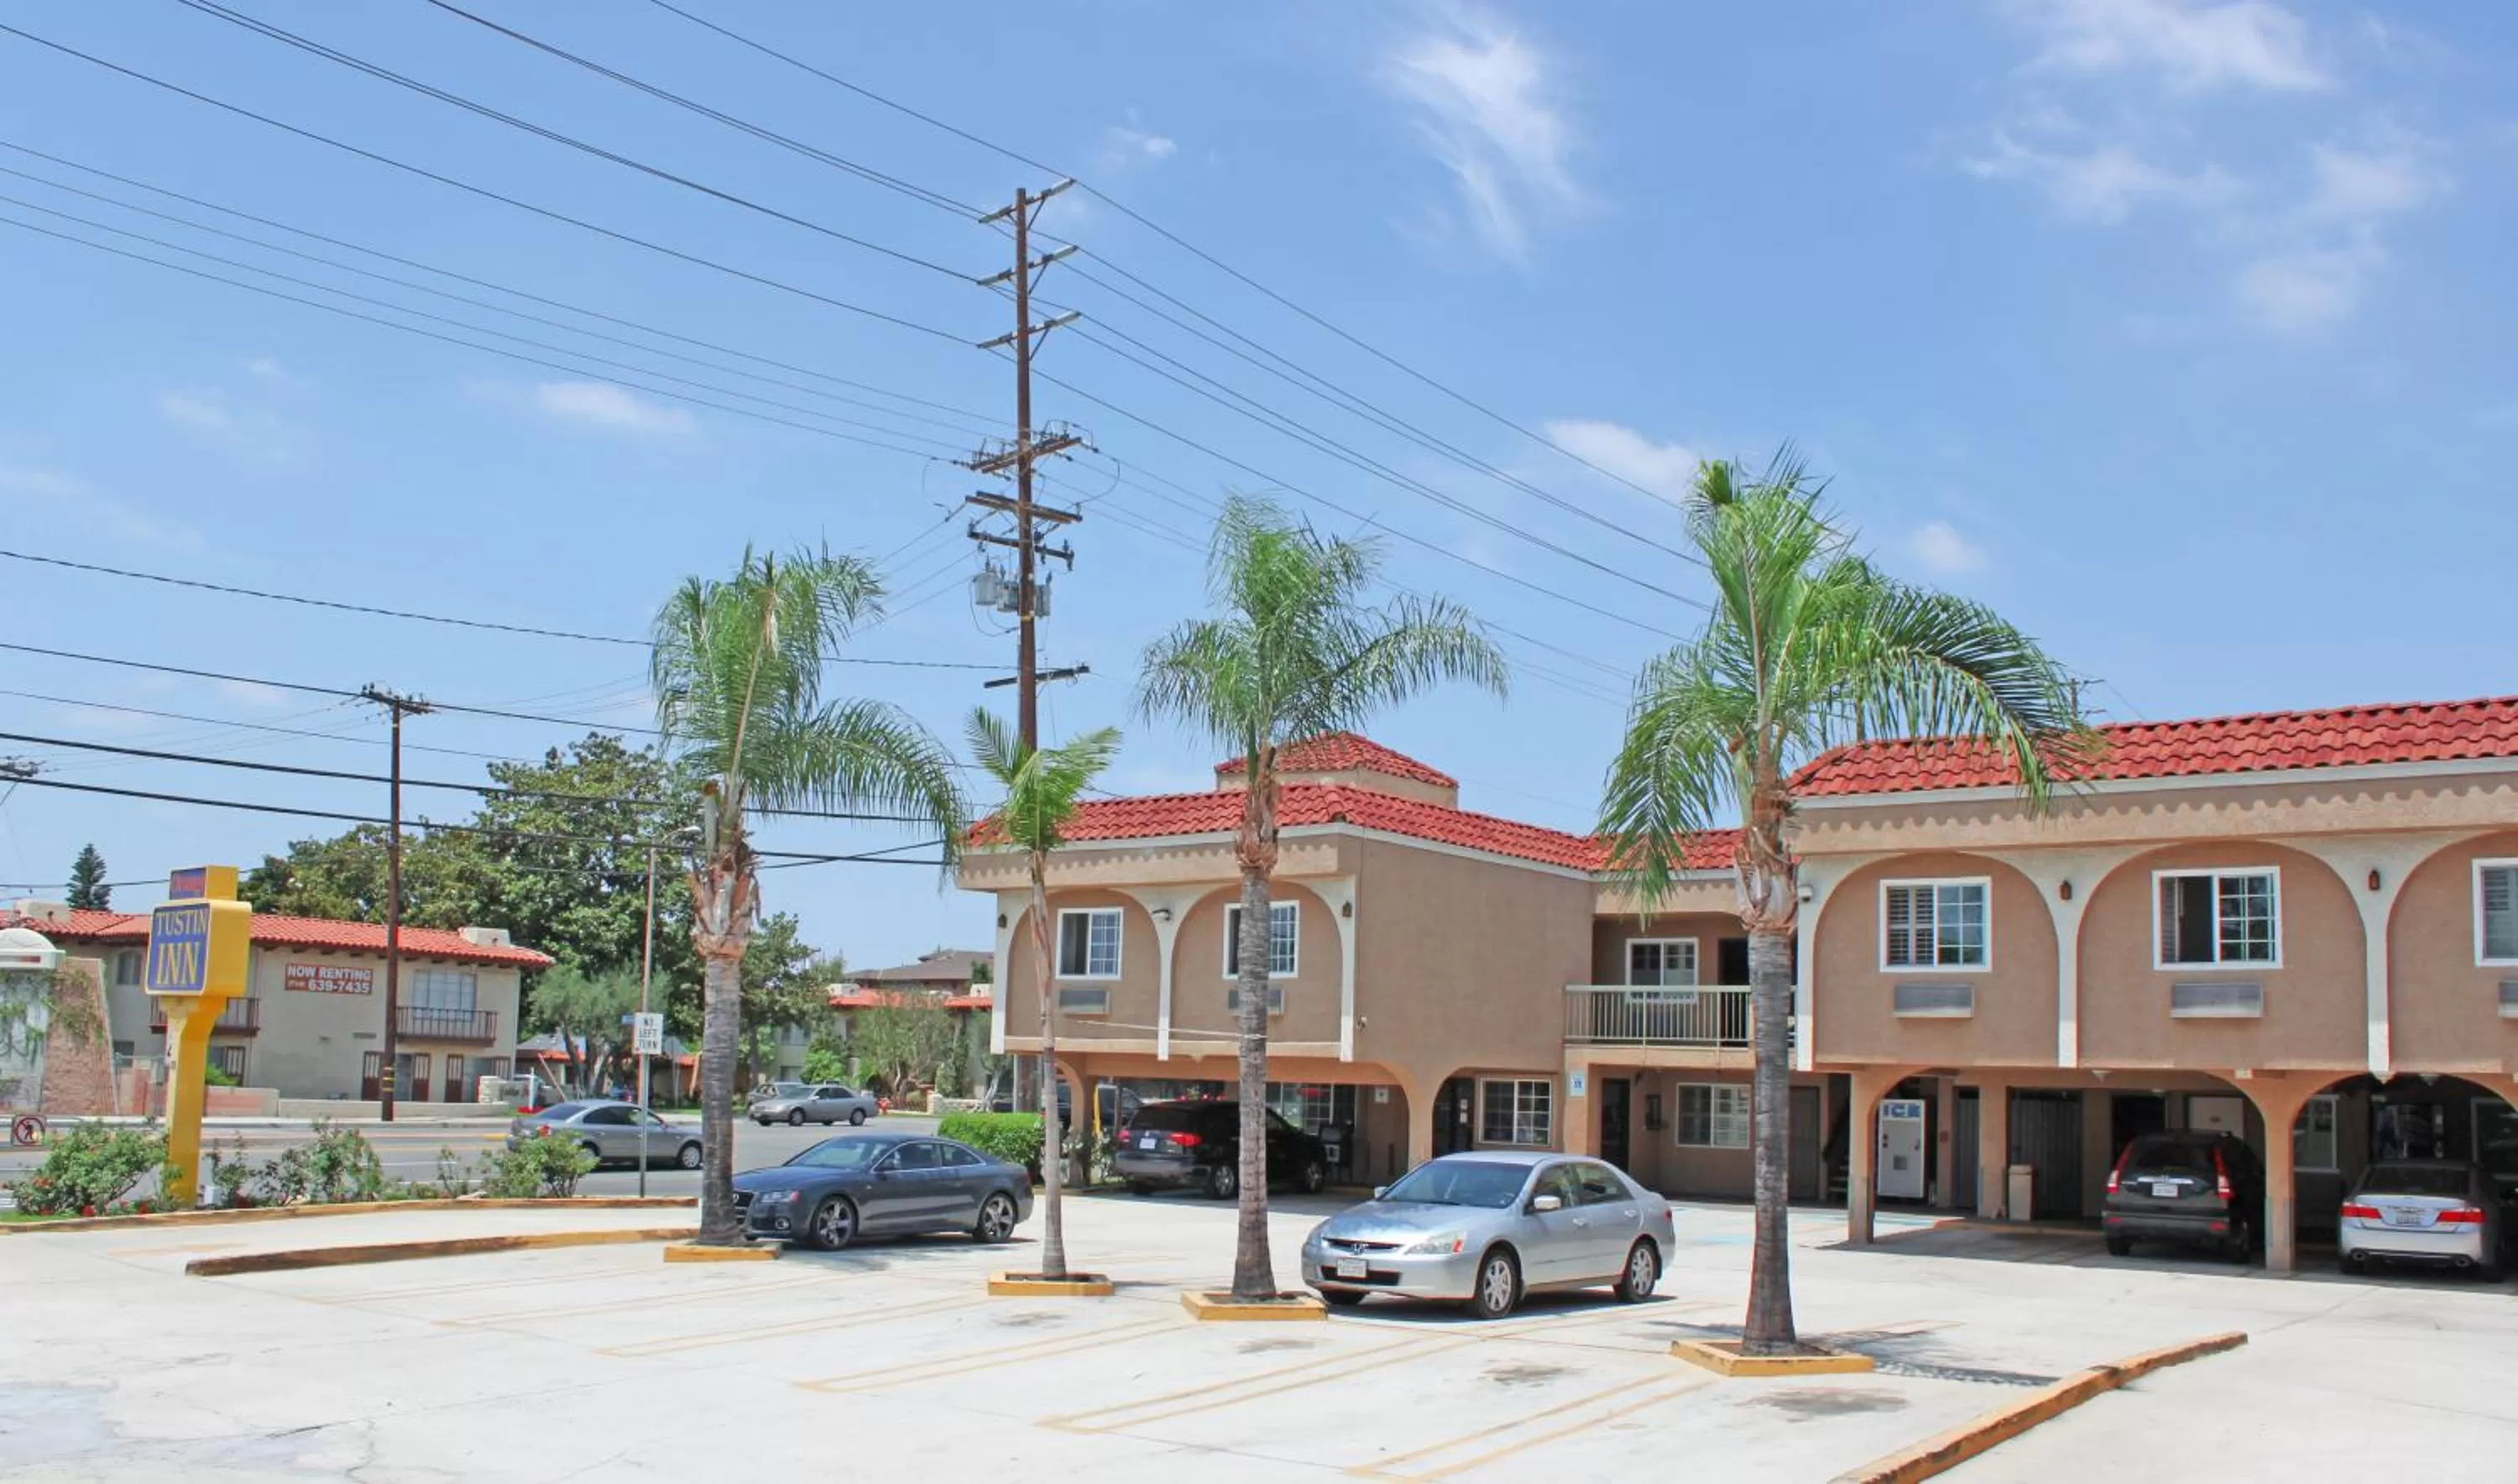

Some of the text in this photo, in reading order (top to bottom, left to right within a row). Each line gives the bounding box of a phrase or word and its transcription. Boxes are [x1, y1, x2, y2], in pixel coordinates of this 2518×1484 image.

[156, 910, 206, 936] TUSTIN
[156, 941, 201, 985] INN
[288, 965, 371, 981] NOW RENTING
[309, 980, 370, 994] 639-7435
[644, 1017, 654, 1027] NO
[639, 1028, 657, 1037] LEFT
[1883, 1104, 1921, 1117] ICE
